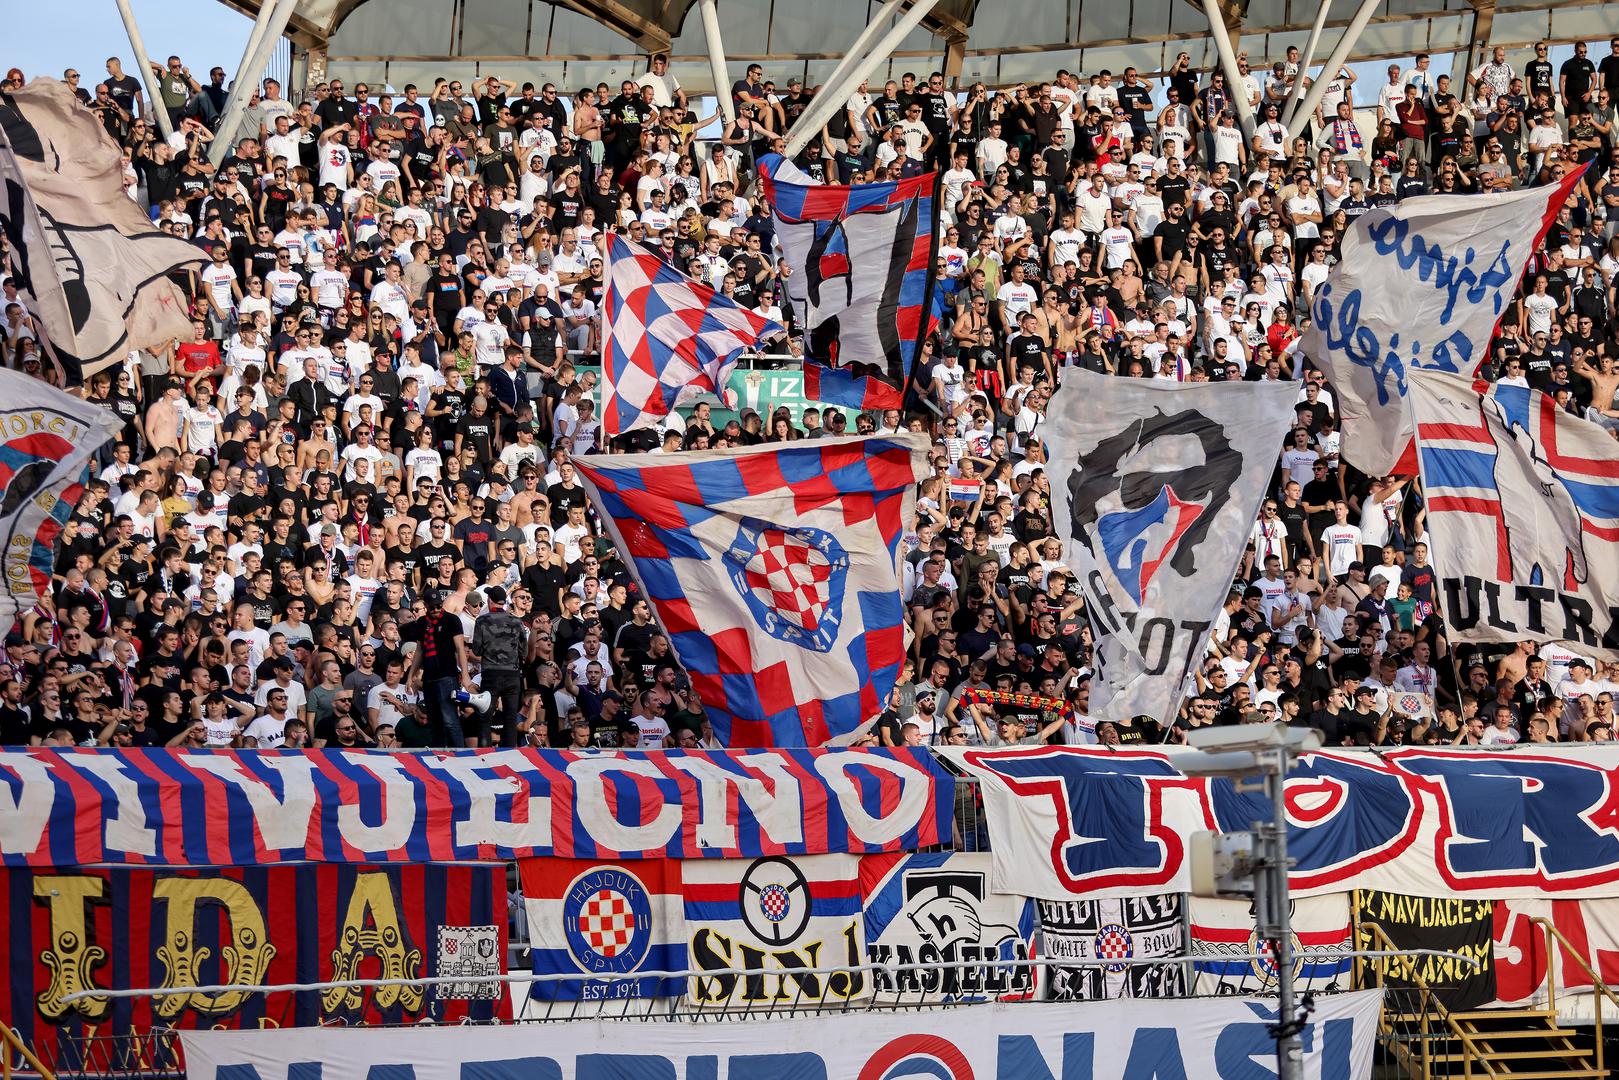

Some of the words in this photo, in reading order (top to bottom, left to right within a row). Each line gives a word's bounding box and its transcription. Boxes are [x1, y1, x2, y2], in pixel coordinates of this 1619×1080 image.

[1529, 360, 1551, 371] TORCIDA
[469, 425, 489, 434] TORCIDA
[416, 456, 438, 464] TORCIDA
[266, 732, 284, 743] HAJ
[572, 872, 640, 904] HAJDUK
[761, 884, 787, 897] HAJDUK
[764, 911, 785, 922] SPLIT
[1097, 925, 1130, 942] HAJDUK
[582, 949, 636, 974] SPLIT
[693, 920, 864, 1001] SINJ
[582, 983, 613, 1000] EST.
[616, 982, 641, 998] 1911
